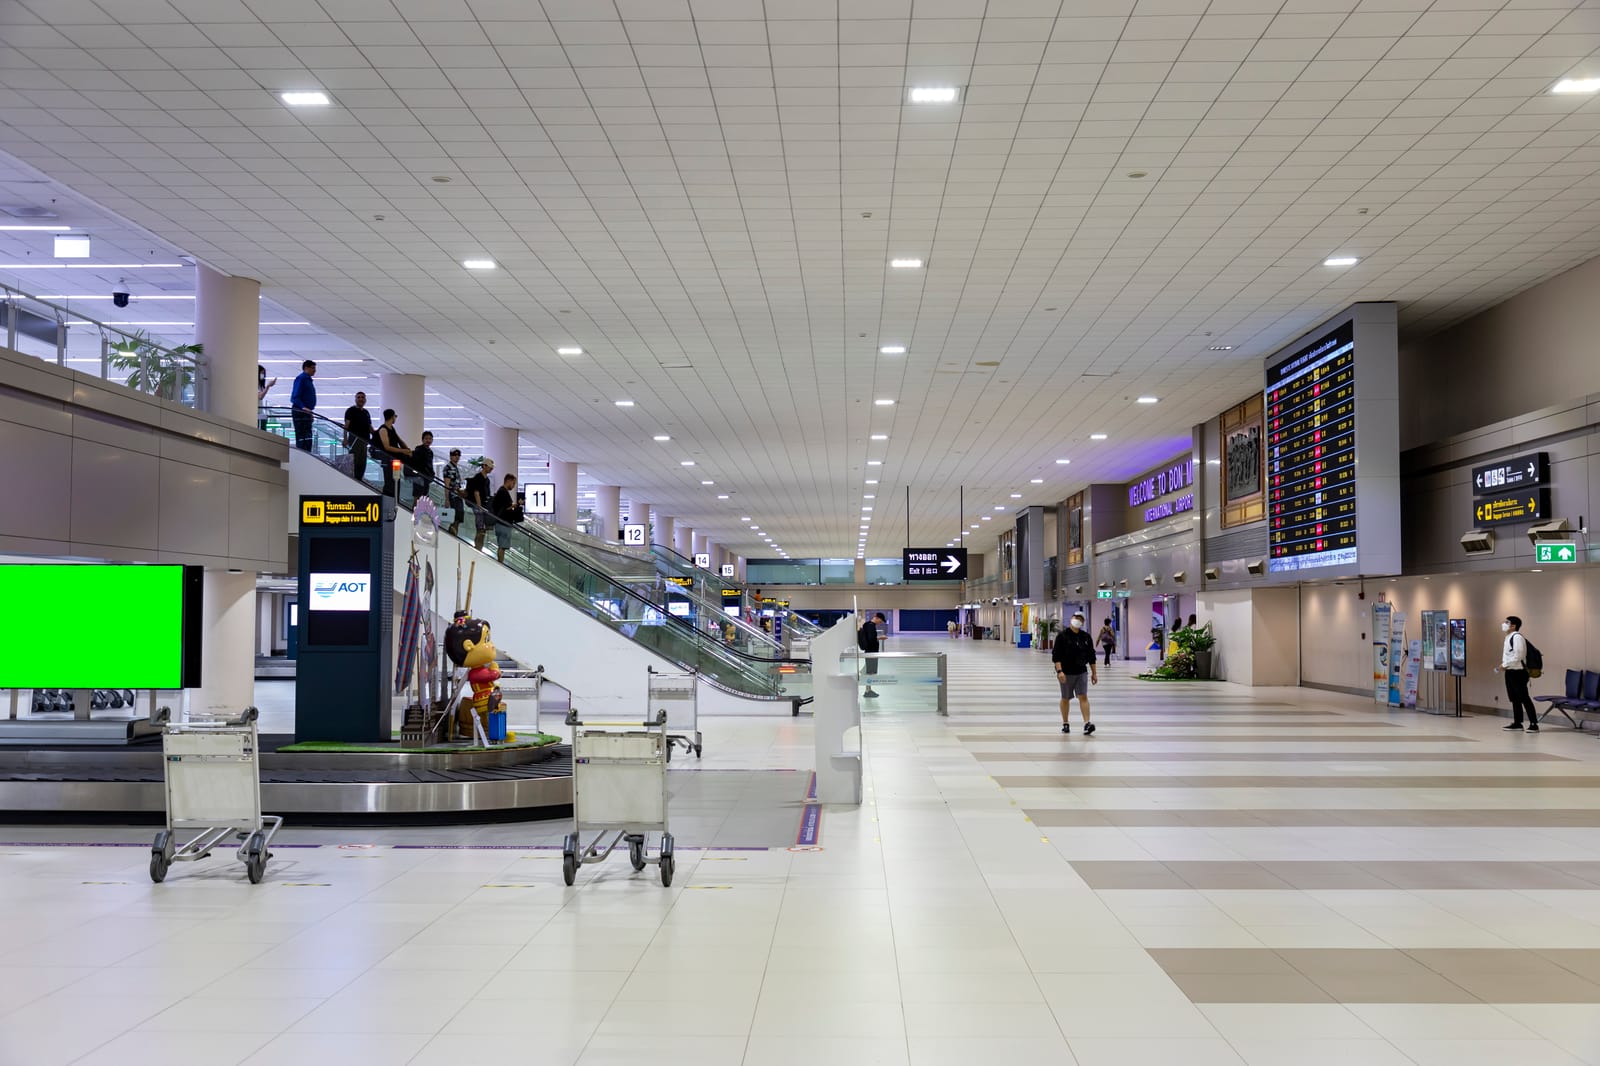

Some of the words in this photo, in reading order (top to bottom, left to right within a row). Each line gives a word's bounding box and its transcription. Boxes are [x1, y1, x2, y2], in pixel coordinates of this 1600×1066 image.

[1129, 477, 1155, 507] WELCOME
[1158, 472, 1166, 496] TO
[1169, 464, 1183, 492] DON
[1186, 459, 1193, 485] M
[533, 491, 547, 507] 11
[366, 503, 379, 522] 10
[1144, 501, 1173, 522] INTERNATIONAL
[628, 529, 641, 541] 12
[698, 557, 707, 565] 14
[908, 553, 937, 561] ทางออก
[724, 566, 732, 574] 15
[338, 582, 367, 592] AOT
